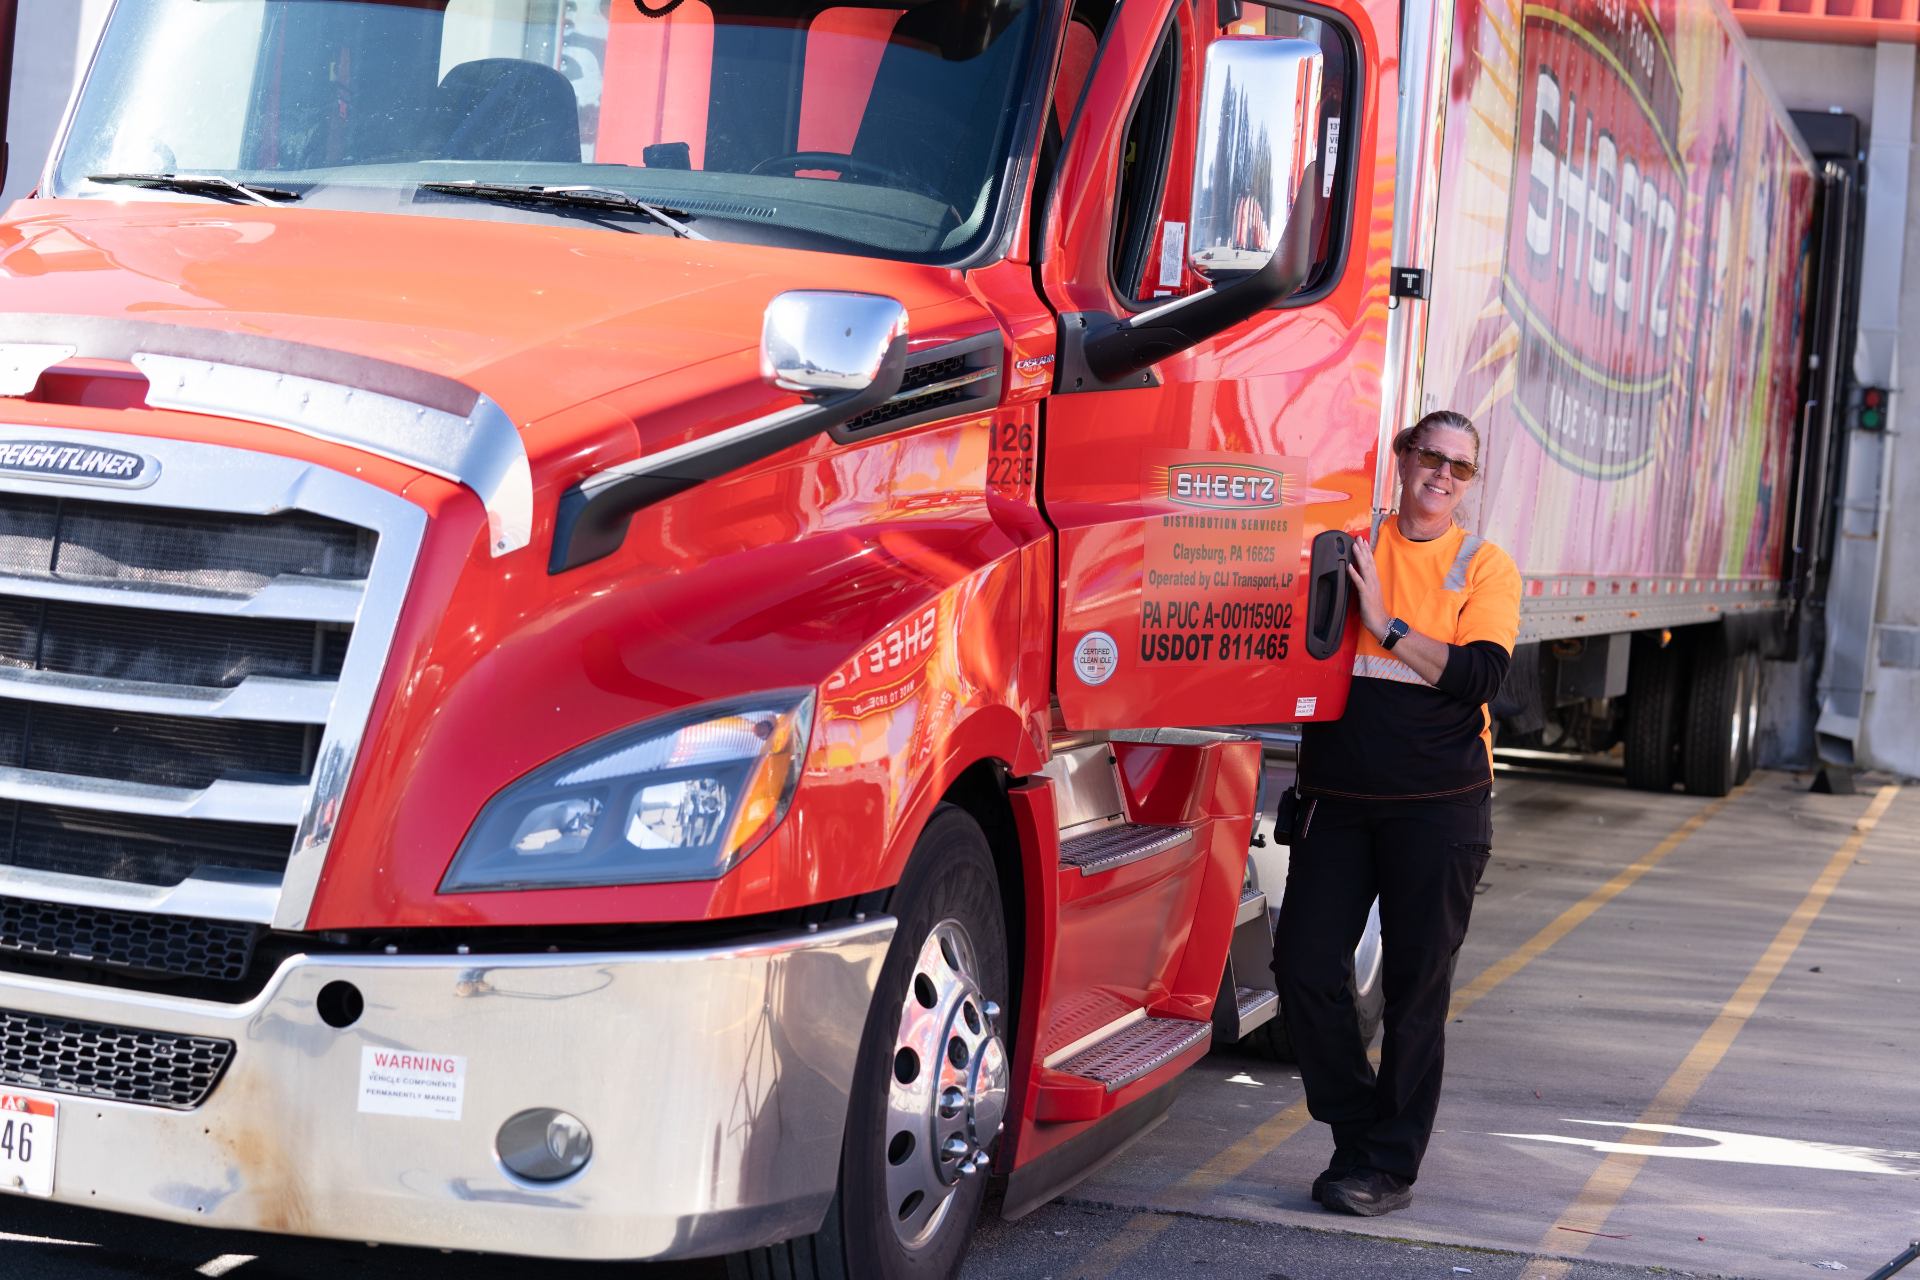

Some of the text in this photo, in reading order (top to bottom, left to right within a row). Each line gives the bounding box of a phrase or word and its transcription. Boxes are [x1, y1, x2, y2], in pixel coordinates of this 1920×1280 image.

[1526, 65, 1676, 338] SHEETZ
[991, 422, 1033, 452] 126
[987, 456, 1033, 486] 2235
[1177, 473, 1275, 501] SHEETZ
[1163, 515, 1288, 532] DISTRIBUTION SERVICES
[1173, 543, 1276, 565] Claysburg, PA 16625
[1148, 569, 1294, 591] Operated by CLI Transport, LP
[1142, 601, 1293, 630] PA PUC A-00115902
[1141, 632, 1290, 662] USDOT 811465
[1079, 656, 1112, 664] CLEAN IDLE
[374, 1053, 455, 1073] WARNING
[368, 1074, 457, 1089] VEHICLE COMPONENTS
[366, 1088, 457, 1103] PERMANENTLY MARKED
